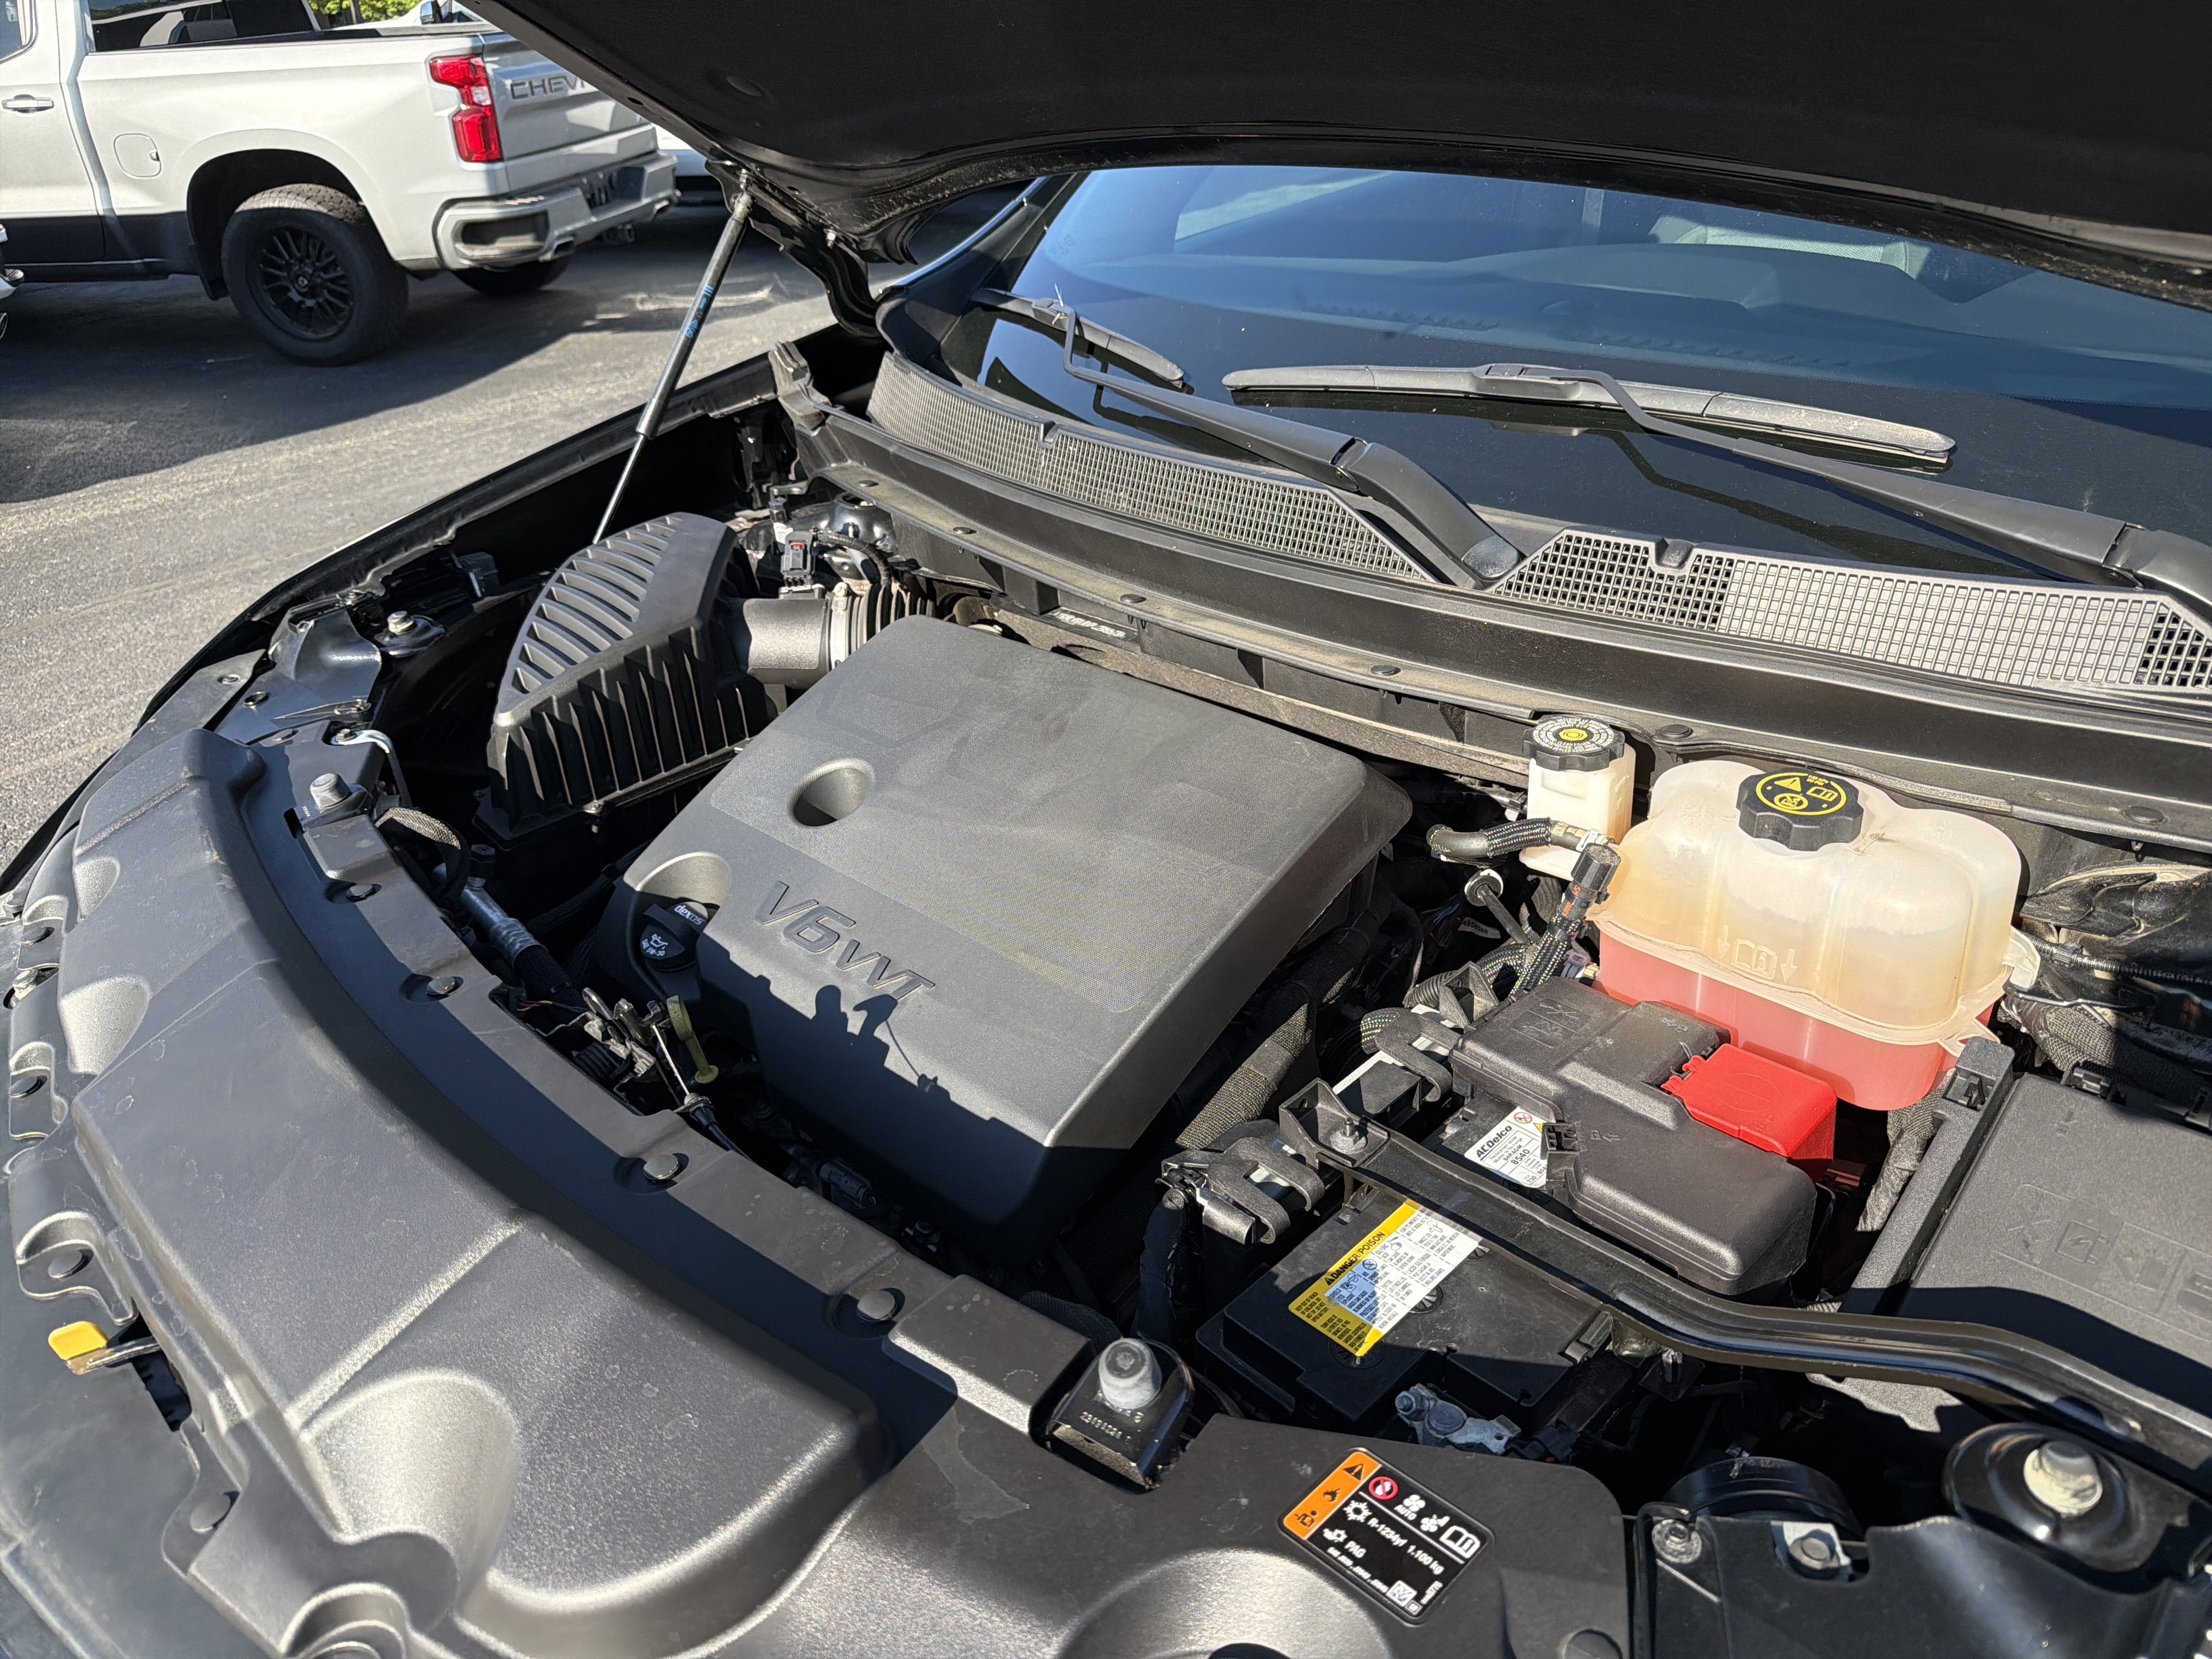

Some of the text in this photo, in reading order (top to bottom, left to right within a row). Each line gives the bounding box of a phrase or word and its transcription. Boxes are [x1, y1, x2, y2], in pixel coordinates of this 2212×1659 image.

[674, 905, 706, 926] dexos
[834, 939, 936, 1001] VVT
[1476, 1125, 1512, 1158] ACDelco
[1511, 1149, 1530, 1165] 8540
[1527, 1175, 1537, 1183] 730
[1329, 1231, 1386, 1279] DANGER/POISON
[1394, 1504, 1417, 1520] AUTO
[1344, 1541, 1367, 1558] PAG
[1406, 1545, 1432, 1565] 1.100
[1429, 1557, 1444, 1576] kg
